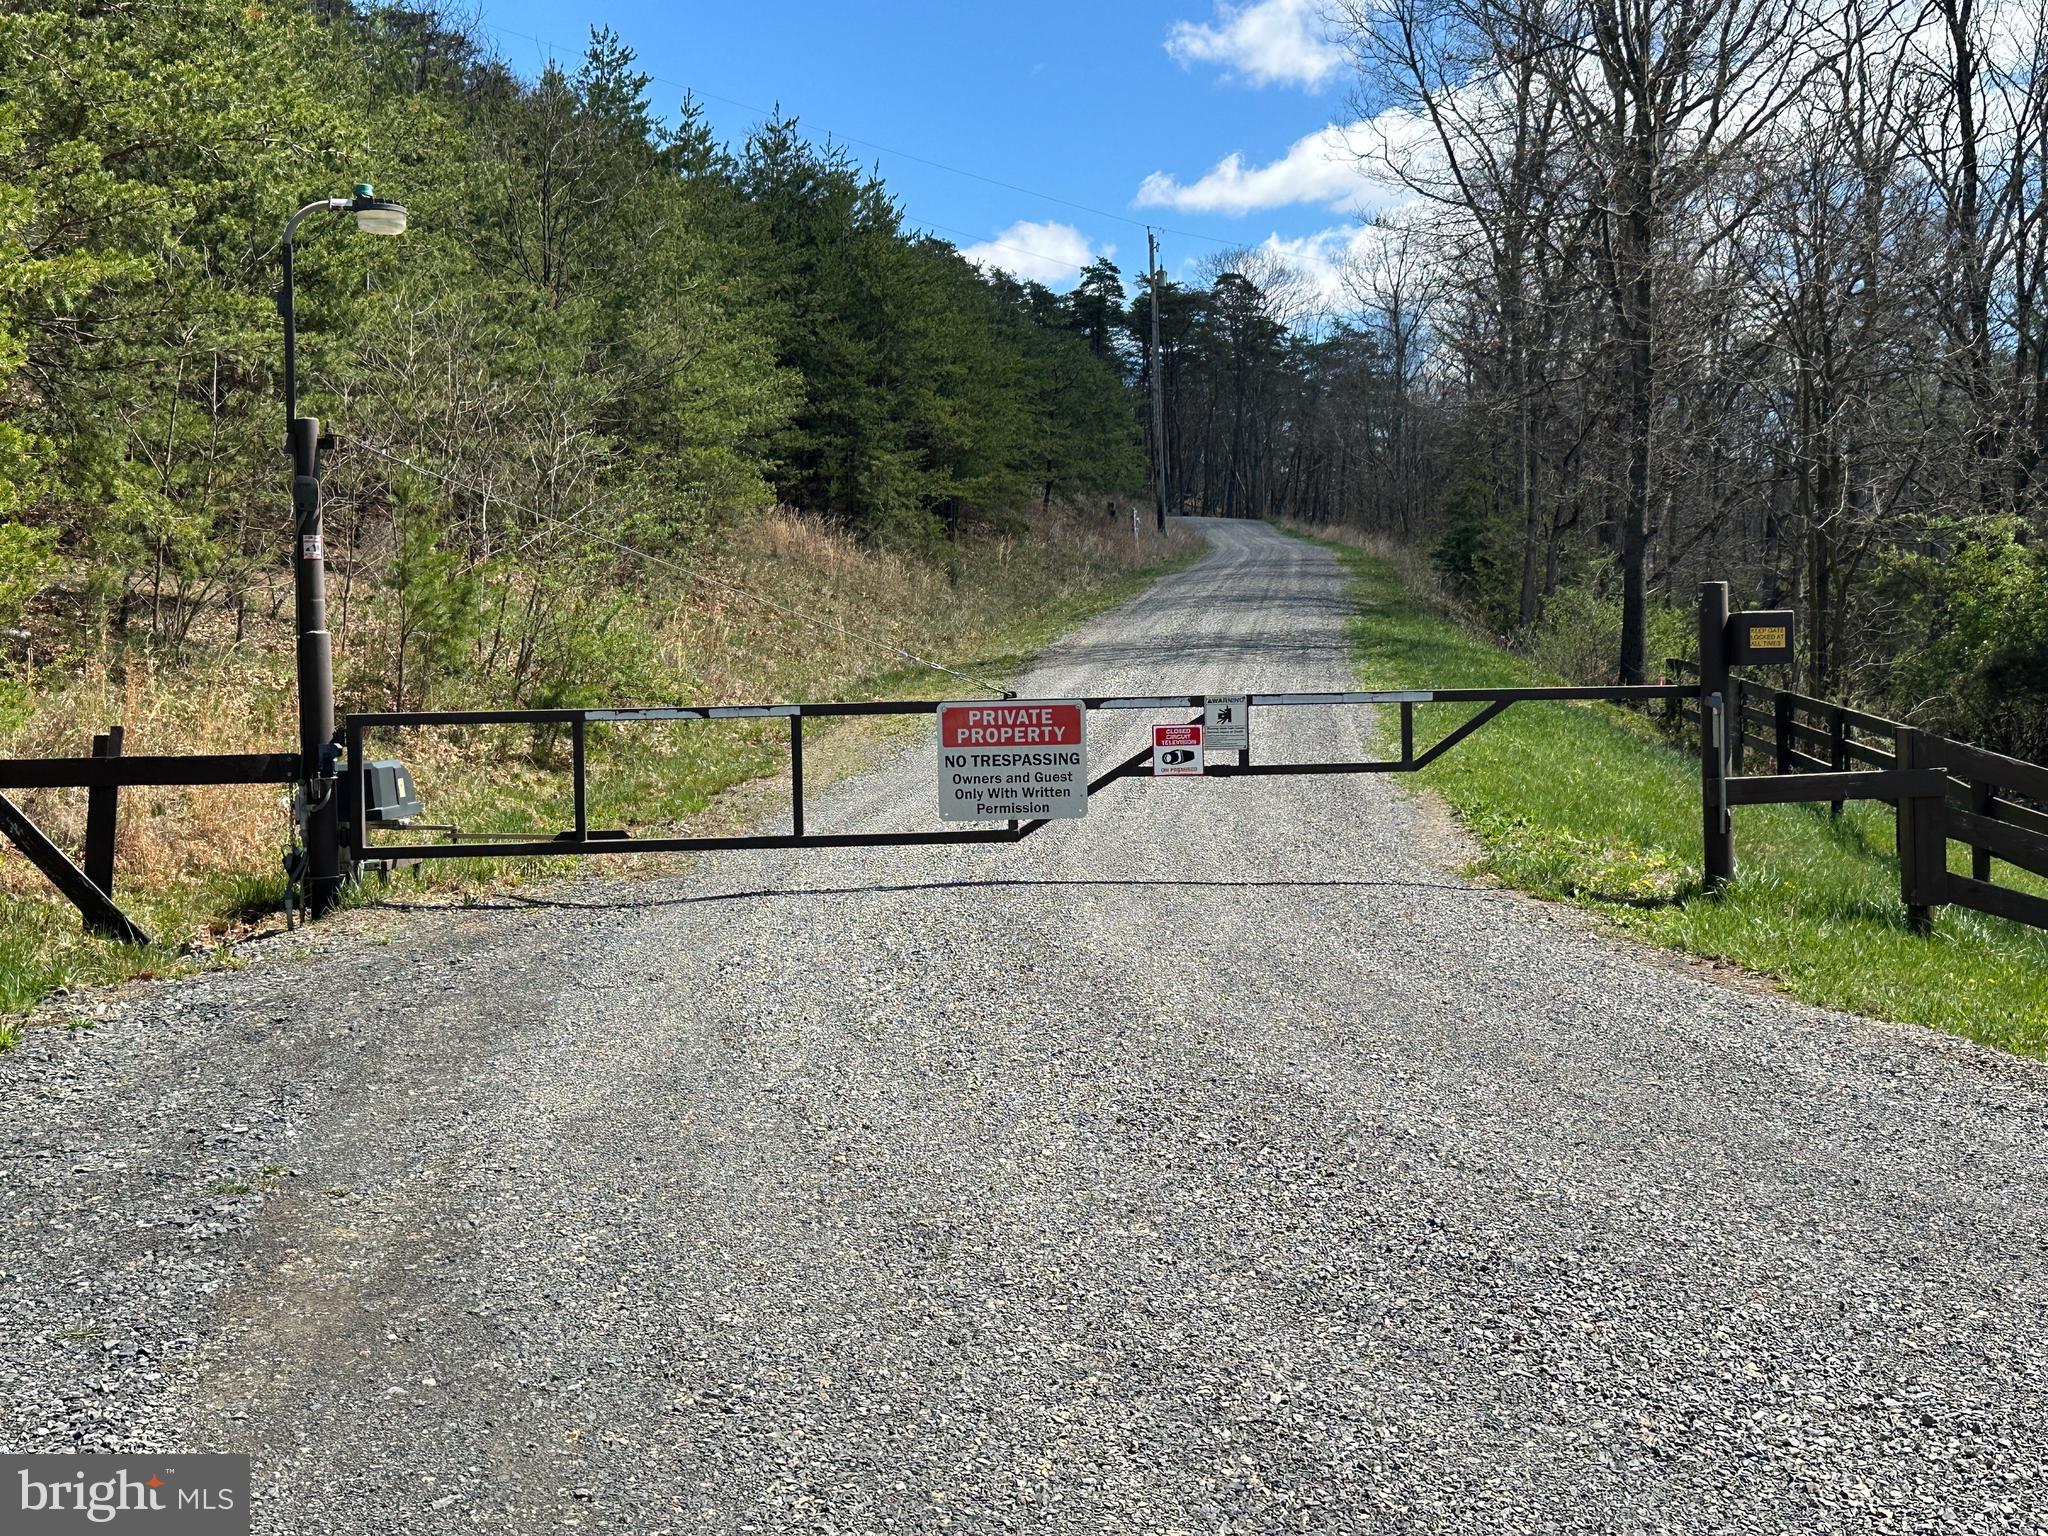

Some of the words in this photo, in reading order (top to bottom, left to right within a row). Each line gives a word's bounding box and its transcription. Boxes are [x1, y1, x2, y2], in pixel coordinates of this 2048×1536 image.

[968, 708, 1053, 726] PRIVATE
[957, 726, 1066, 744] PROPERTY
[944, 755, 967, 768] NO
[971, 752, 1080, 767] TRESPASSING
[952, 773, 1002, 785] Owners
[1006, 772, 1030, 784] and
[1034, 771, 1073, 783] Guest
[955, 788, 984, 801] Only
[988, 787, 1018, 799] With
[1022, 786, 1071, 798] Written
[977, 801, 1050, 815] Permission
